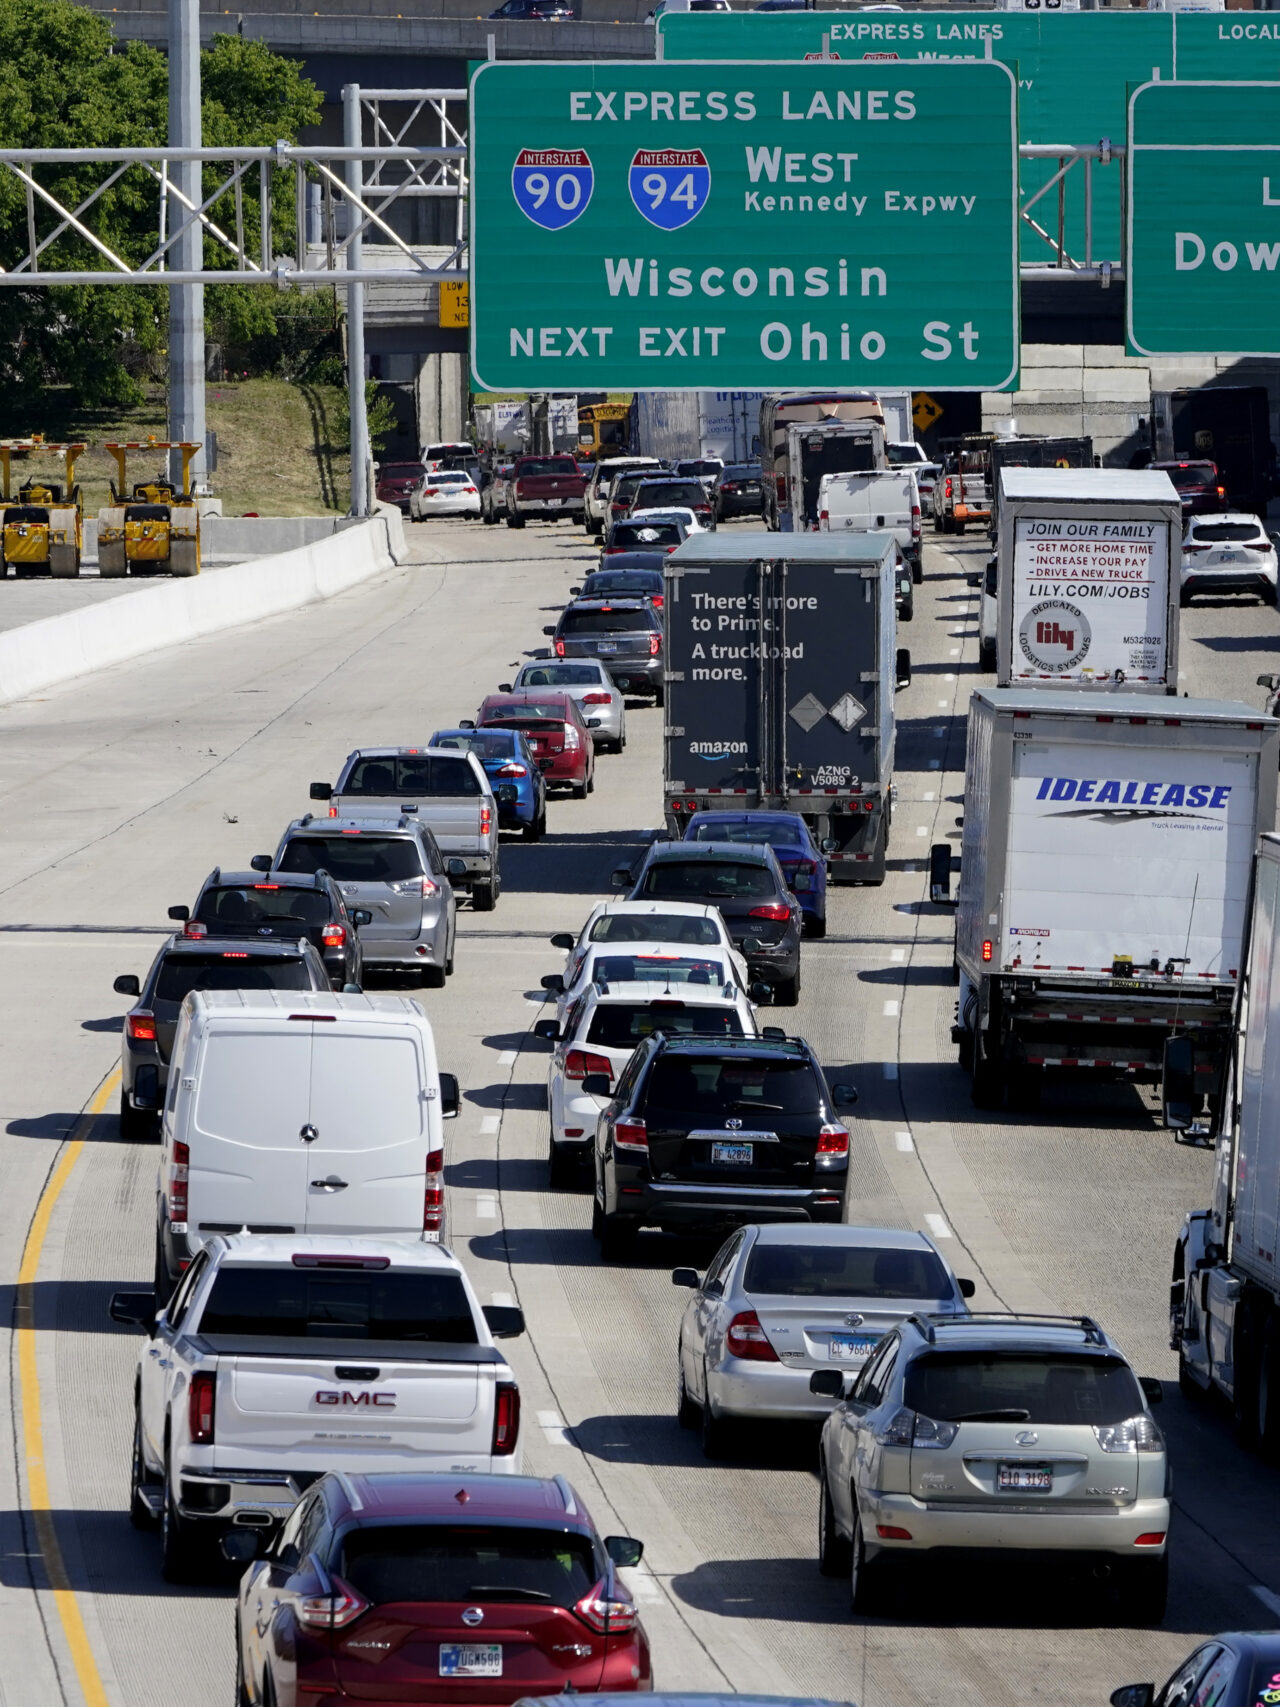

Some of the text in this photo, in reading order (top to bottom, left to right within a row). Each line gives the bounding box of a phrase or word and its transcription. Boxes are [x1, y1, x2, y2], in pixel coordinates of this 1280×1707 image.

[830, 24, 1004, 40] EXPRESS LANES
[571, 91, 916, 120] EXPRESS LANES
[523, 153, 582, 165] INTERSTATE
[640, 153, 699, 165] INTERSTATE
[525, 173, 581, 210] 90
[642, 173, 697, 210] 94
[746, 191, 976, 215] Kennedy Expwy
[605, 259, 886, 296] Wisconsin
[446, 282, 464, 291] LOW
[454, 313, 469, 322] NE
[510, 321, 978, 360] NEXT EXIT Ohio St
[1028, 523, 1155, 538] JOIN OUR FAMILY
[1060, 544, 1091, 553] MORE
[1094, 544, 1126, 554] HOME
[1129, 545, 1153, 555] TIME
[1092, 557, 1121, 566] YOUR
[1125, 558, 1147, 567] PAY
[1070, 569, 1079, 577] A
[1081, 569, 1105, 578] NEW
[1109, 570, 1143, 579] TRUCK
[1029, 584, 1150, 599] LILY.COM/JOBS
[692, 593, 818, 610] There's more
[1031, 600, 1082, 617] DEDICATED
[691, 615, 780, 631] to Prime.
[1036, 621, 1075, 651] lily
[691, 642, 804, 659] A truckload
[1019, 632, 1092, 672] LOGISTICS SYSTEMS
[692, 667, 748, 681] more.
[690, 742, 748, 753] amazon
[817, 765, 851, 777] AZNG
[1036, 777, 1232, 809] IDEALEASE
[1170, 823, 1195, 831] Leasing
[316, 1391, 397, 1406] GMC
